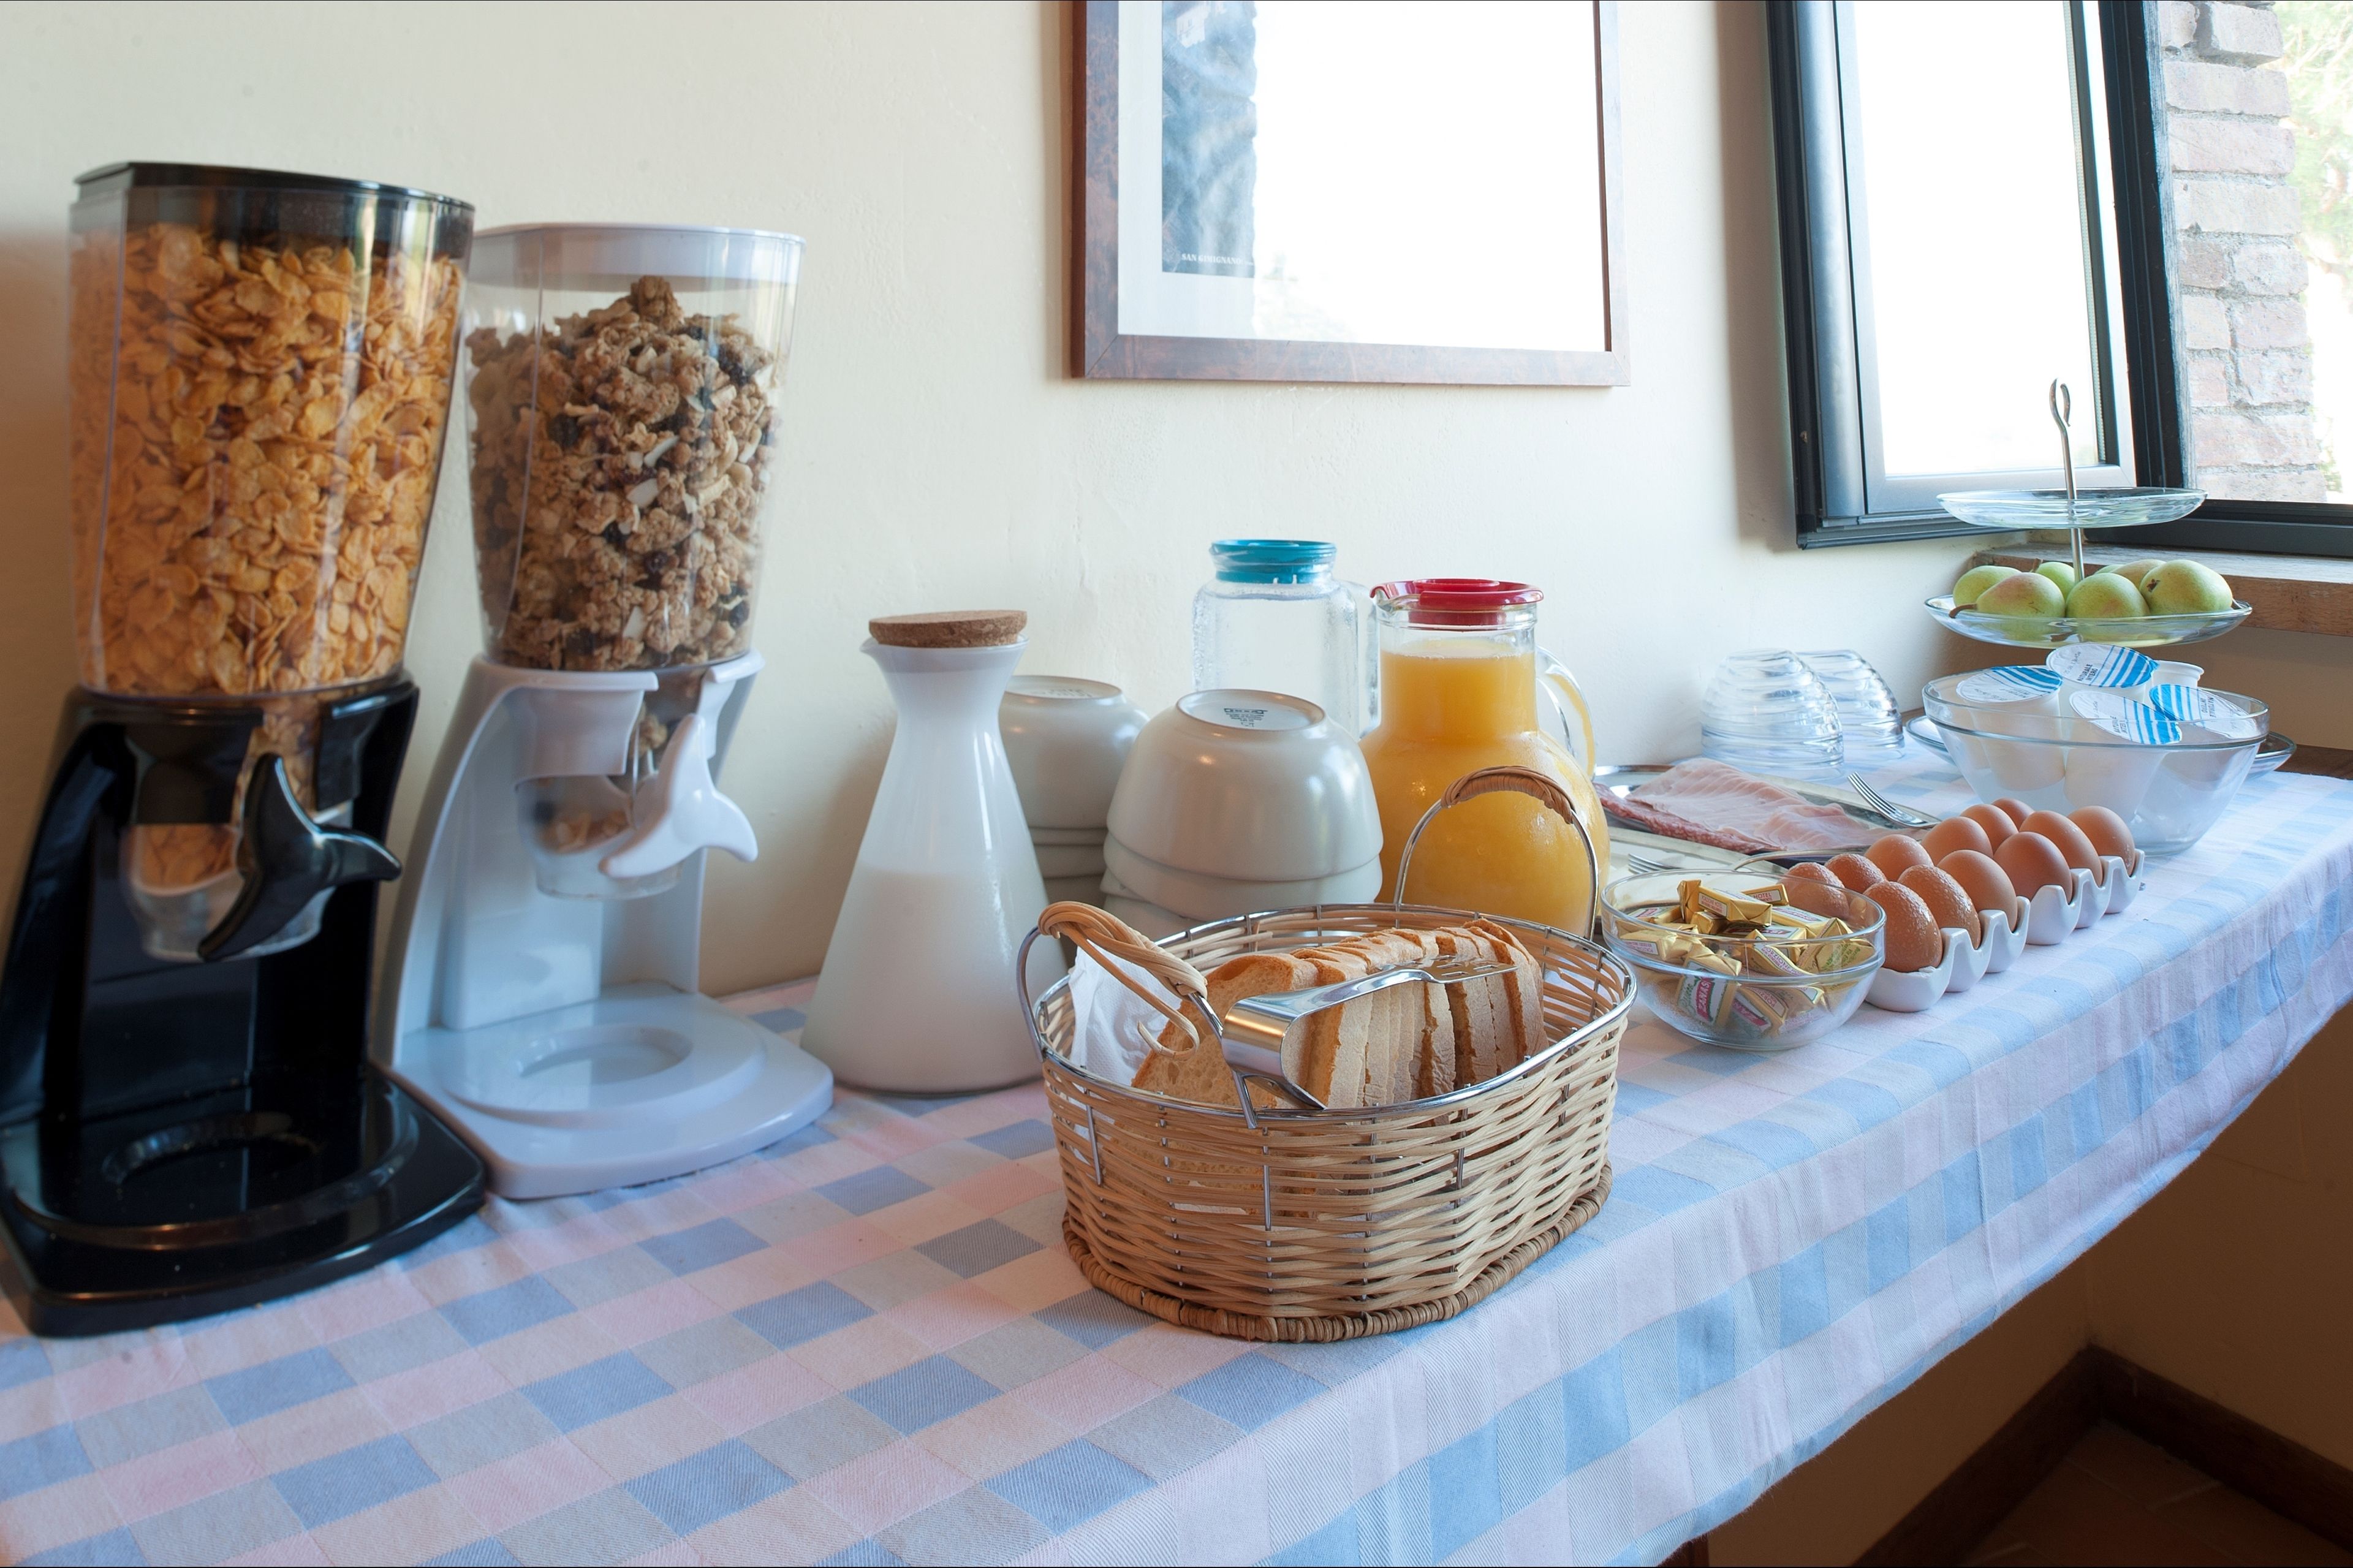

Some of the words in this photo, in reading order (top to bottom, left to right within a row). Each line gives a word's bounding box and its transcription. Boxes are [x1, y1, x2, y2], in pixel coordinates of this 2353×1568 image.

[1181, 253, 1197, 262] SAN
[1198, 254, 1241, 265] GIMIGNANO
[2077, 664, 2093, 681] NATURALE
